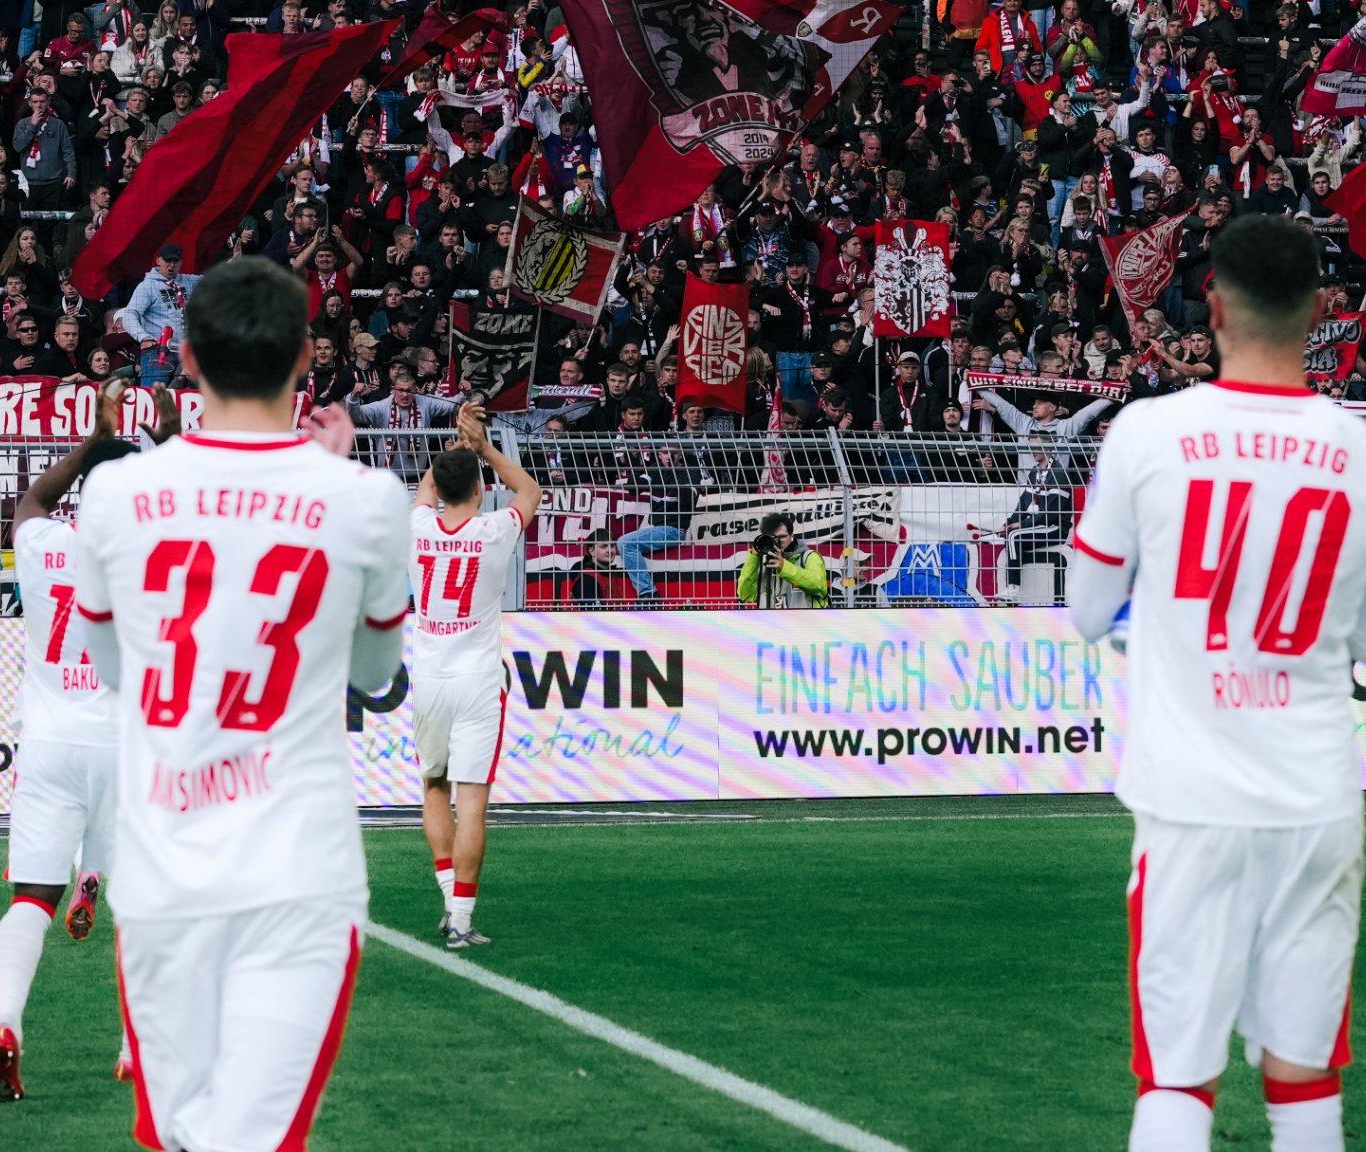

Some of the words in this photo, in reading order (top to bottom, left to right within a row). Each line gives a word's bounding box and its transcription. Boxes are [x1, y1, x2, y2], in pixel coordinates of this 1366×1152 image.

[1180, 432, 1220, 463] RB
[1236, 432, 1350, 475] LEIPZIG
[134, 491, 176, 524] RB
[196, 486, 327, 530] LEIPZIG
[45, 552, 66, 569] RB
[416, 538, 431, 551] RB
[435, 540, 483, 553] LEIPZIG
[1174, 479, 1352, 656] 40
[417, 555, 480, 619] 14
[141, 539, 330, 732] 33
[756, 641, 928, 715] EINFACH
[949, 639, 1106, 713] SAUBER
